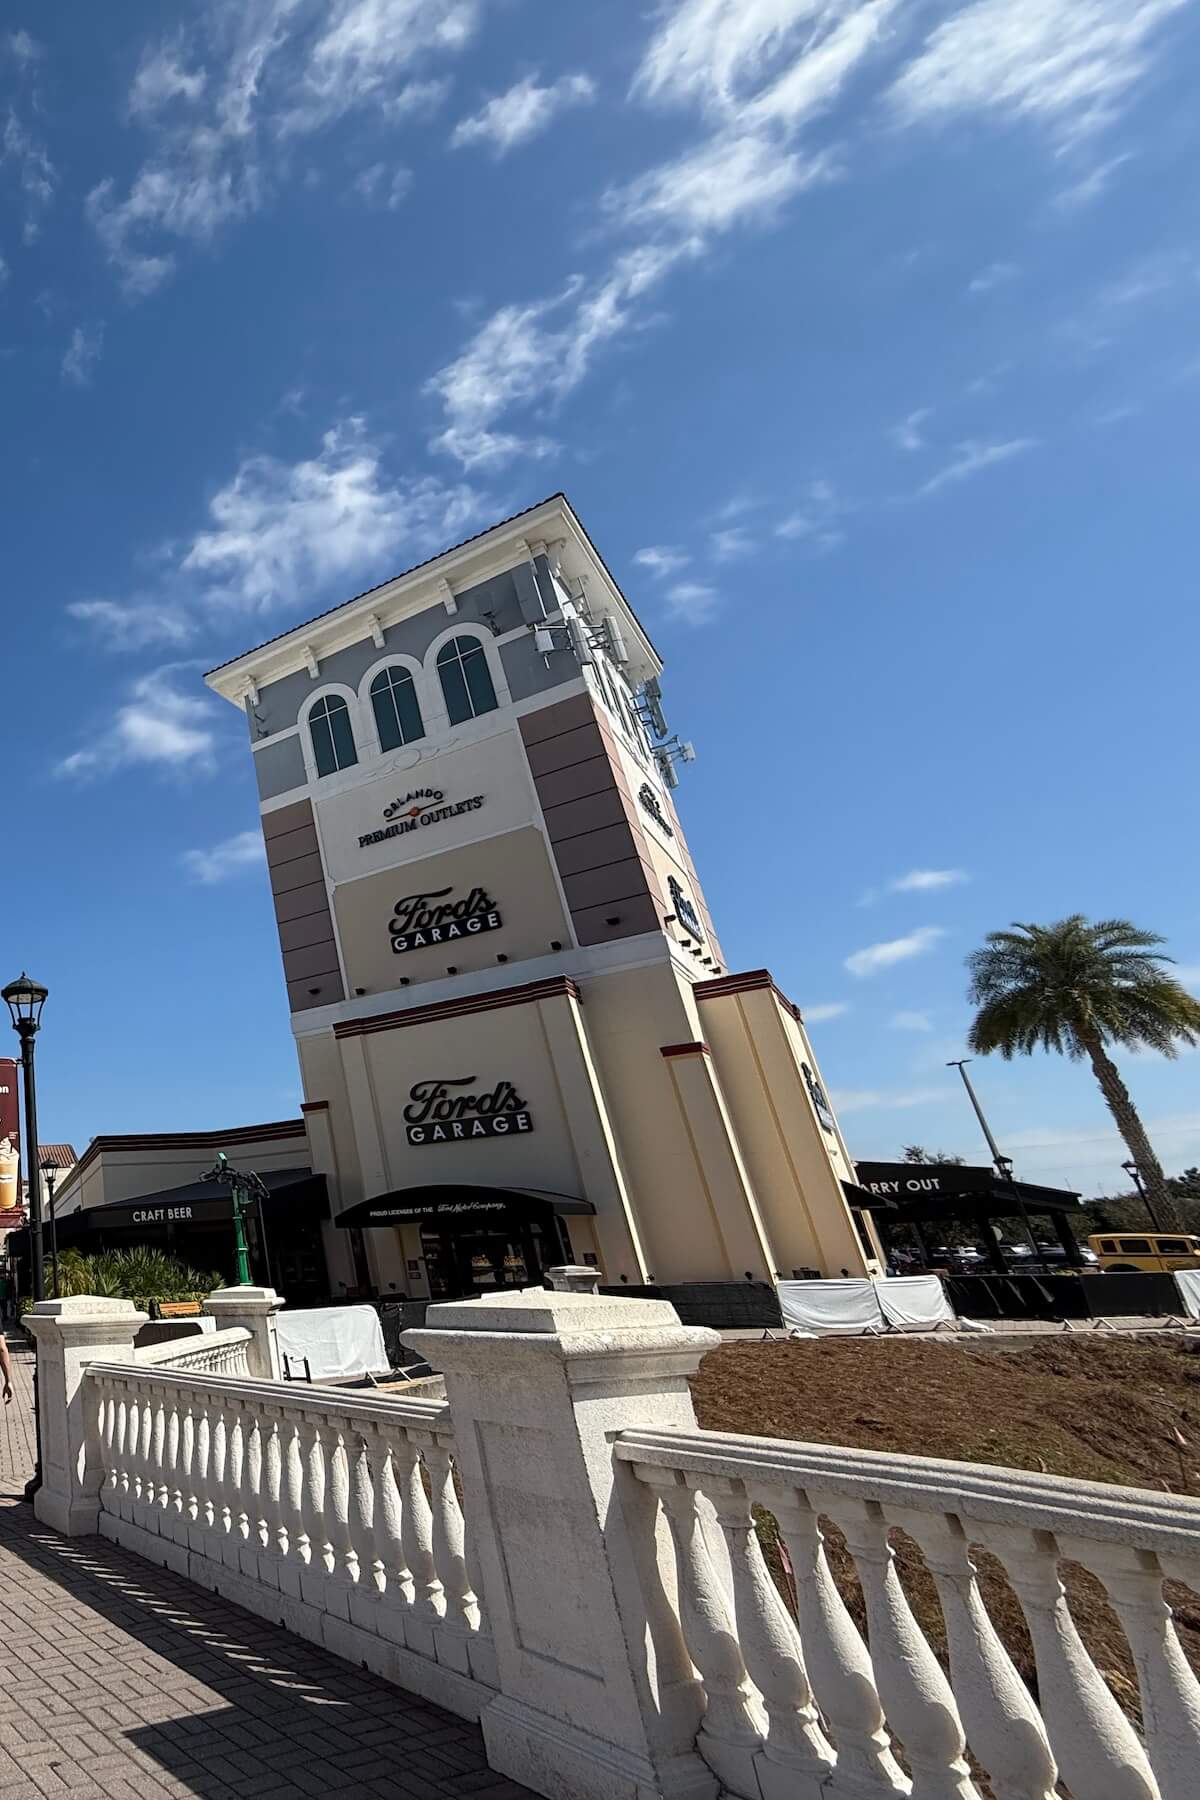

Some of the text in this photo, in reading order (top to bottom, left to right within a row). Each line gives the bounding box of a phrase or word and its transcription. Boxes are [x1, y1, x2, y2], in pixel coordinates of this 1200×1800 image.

[383, 788, 444, 818] ORLANDO
[357, 818, 418, 848] PREMIUM
[388, 886, 497, 935] Ford's
[394, 913, 498, 950] GARAGE
[403, 1075, 528, 1124] Ford's
[410, 1114, 529, 1143] GARAGE
[859, 1178, 941, 1194] ARRY OUT
[132, 1206, 193, 1222] CRAFT BEER
